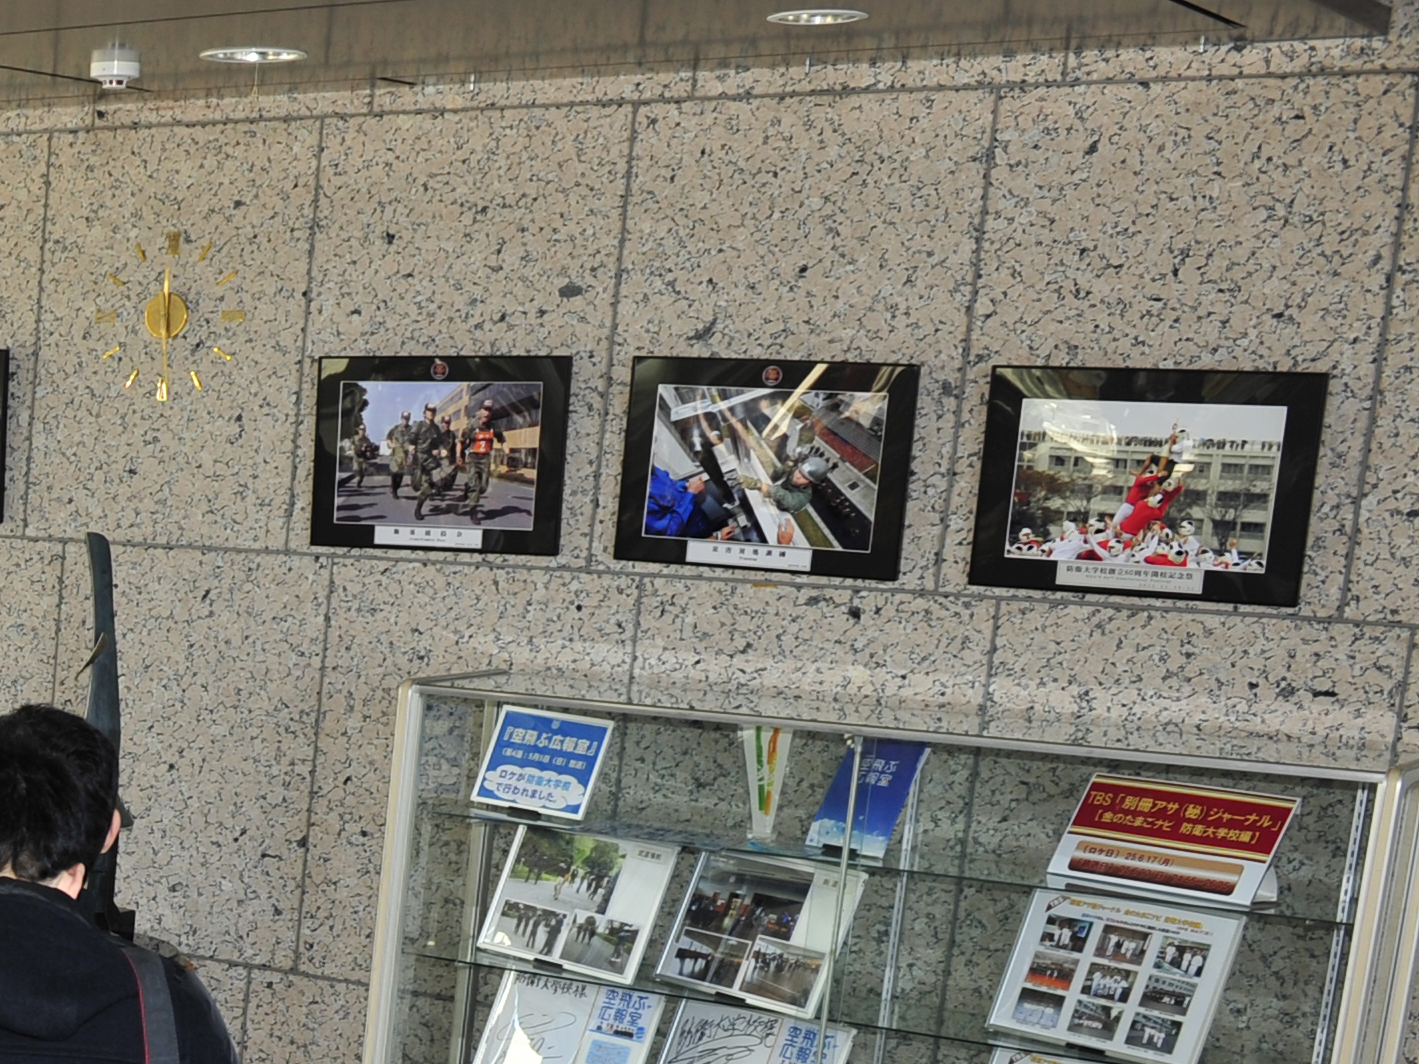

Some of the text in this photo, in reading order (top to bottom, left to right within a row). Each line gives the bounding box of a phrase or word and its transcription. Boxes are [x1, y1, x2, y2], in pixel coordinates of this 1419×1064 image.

[602, 989, 652, 1011] 空飛ぶ
[598, 1005, 642, 1028] 広報室
